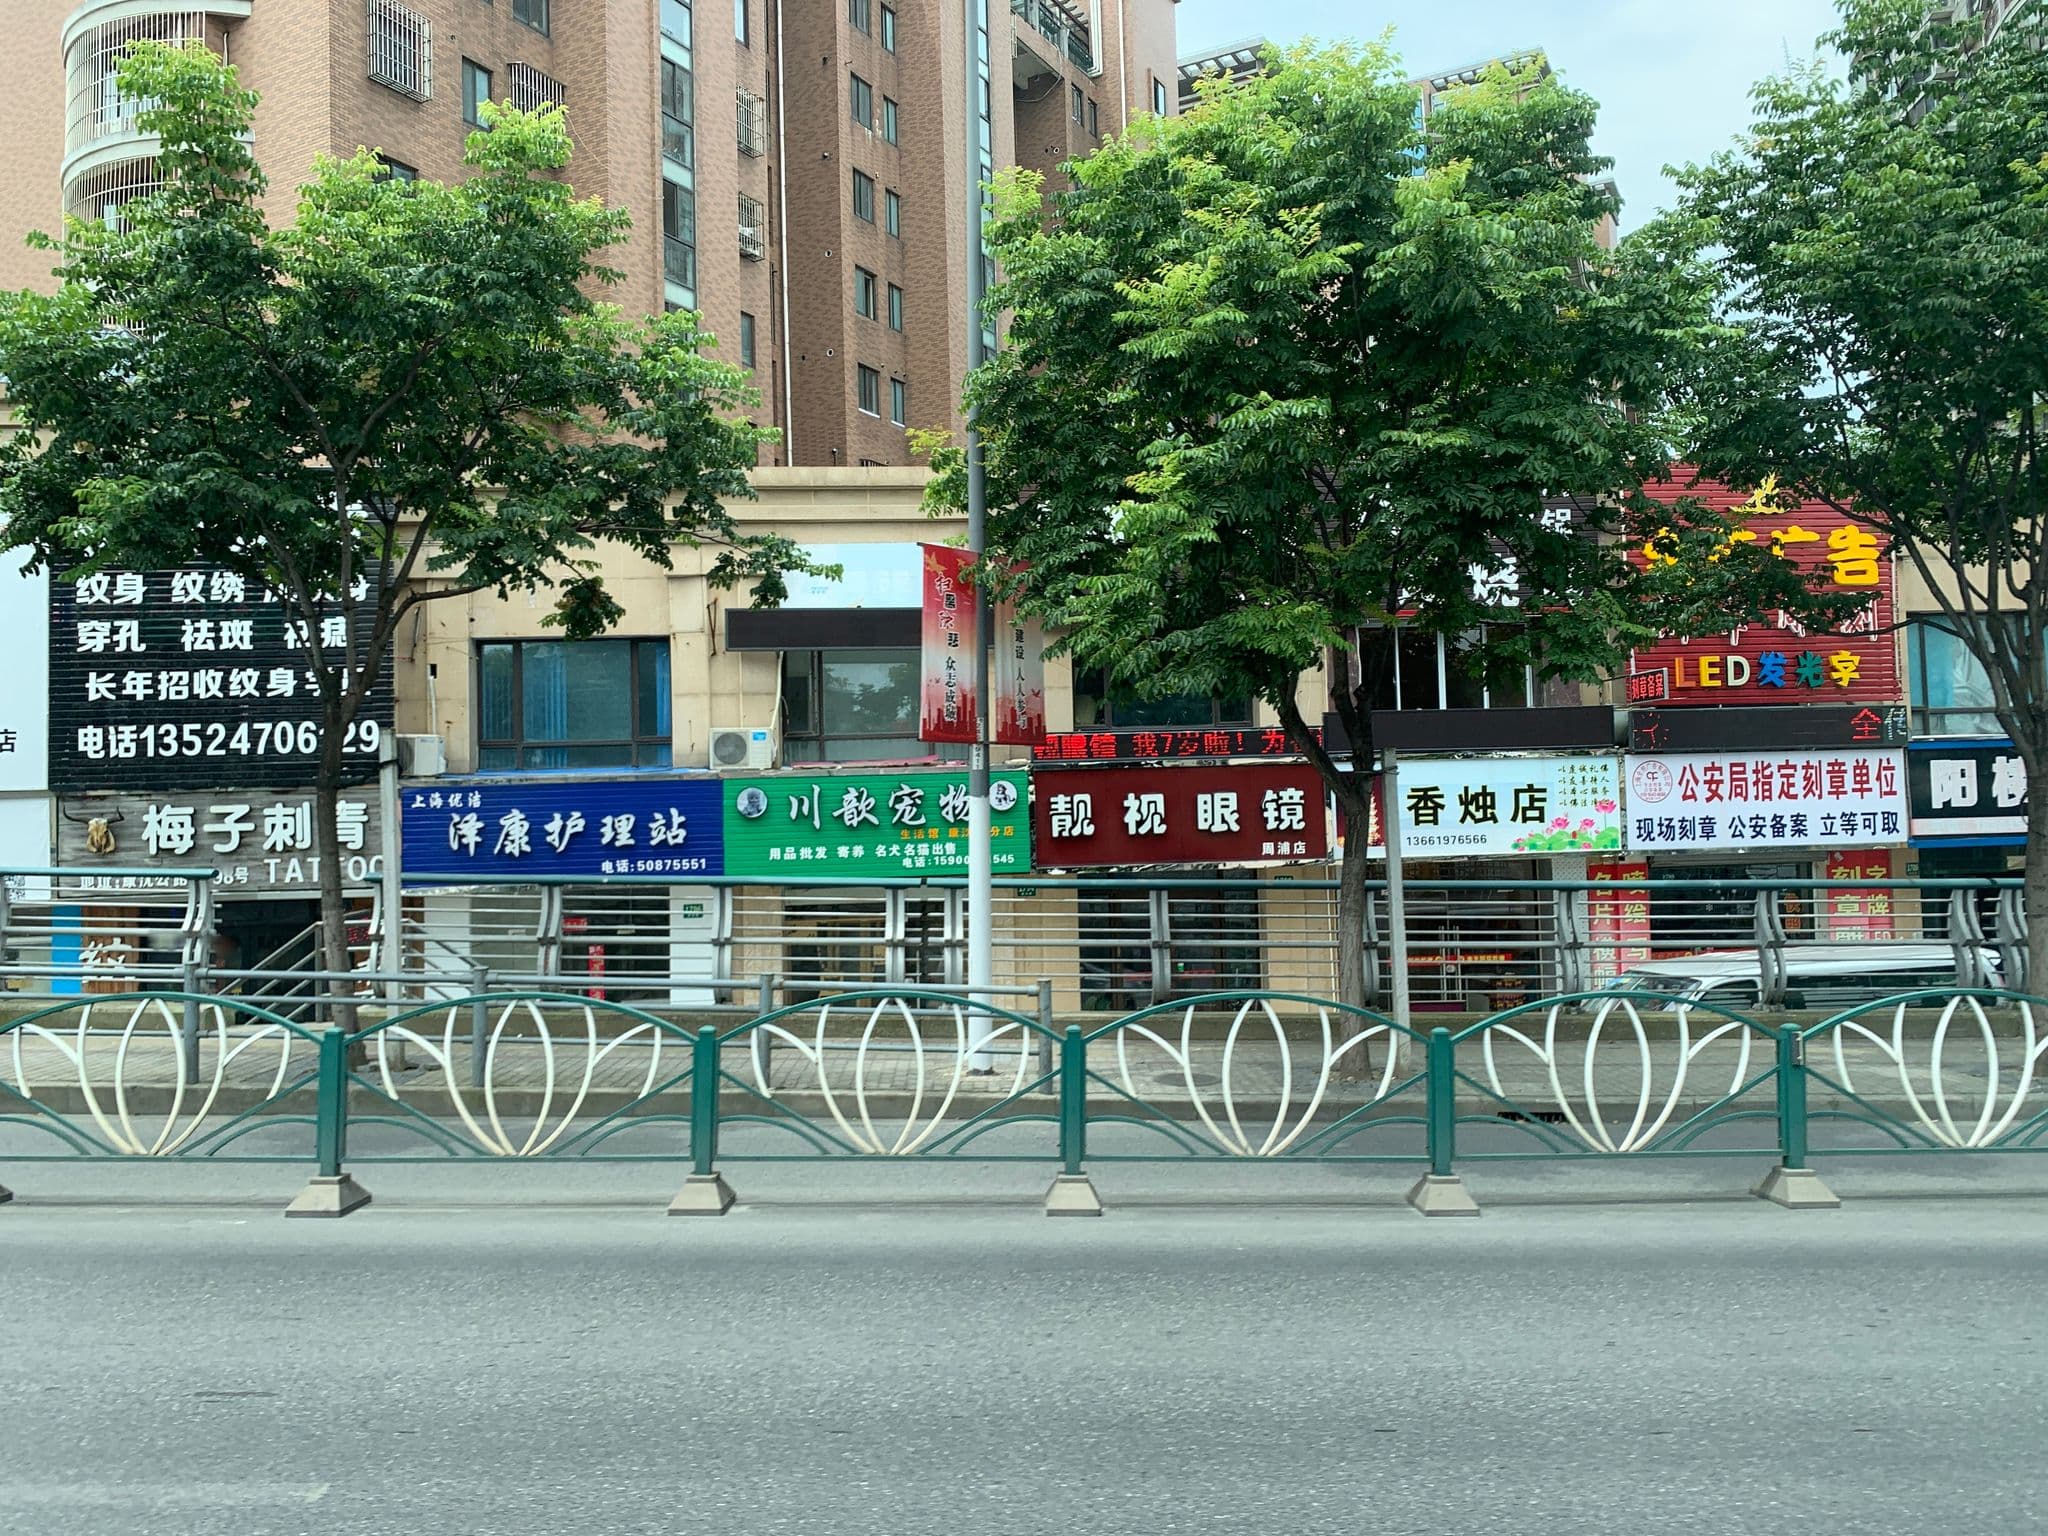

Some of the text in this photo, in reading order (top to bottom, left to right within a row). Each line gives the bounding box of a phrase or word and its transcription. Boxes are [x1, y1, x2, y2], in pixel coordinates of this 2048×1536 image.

[75, 572, 147, 604] 纹身
[171, 571, 245, 603] 纹绣
[76, 619, 146, 653] 穿孔
[181, 619, 253, 652] 祛斑
[77, 719, 379, 760] 电话1352470629
[1677, 757, 1899, 803] 公安局指定刻章单位
[411, 790, 482, 809] 上海优洁
[1049, 787, 1306, 839] 靓视眼镜
[1406, 784, 1548, 827] 香烛店
[142, 800, 369, 857] 梅子刺青
[449, 808, 688, 857] 泽康护理站
[1406, 834, 1487, 847] 13661976566
[1636, 811, 1900, 842] 现场刻章 公安备案 立等可取
[769, 842, 957, 861] 用品批发 寄养 名犬名猫出售
[902, 853, 1015, 869] 电话:15900545
[1262, 840, 1307, 857] 周浦店
[263, 855, 384, 884] TATO
[601, 857, 706, 874] 电话:50875551
[1623, 871, 1648, 968] 喷绘写
